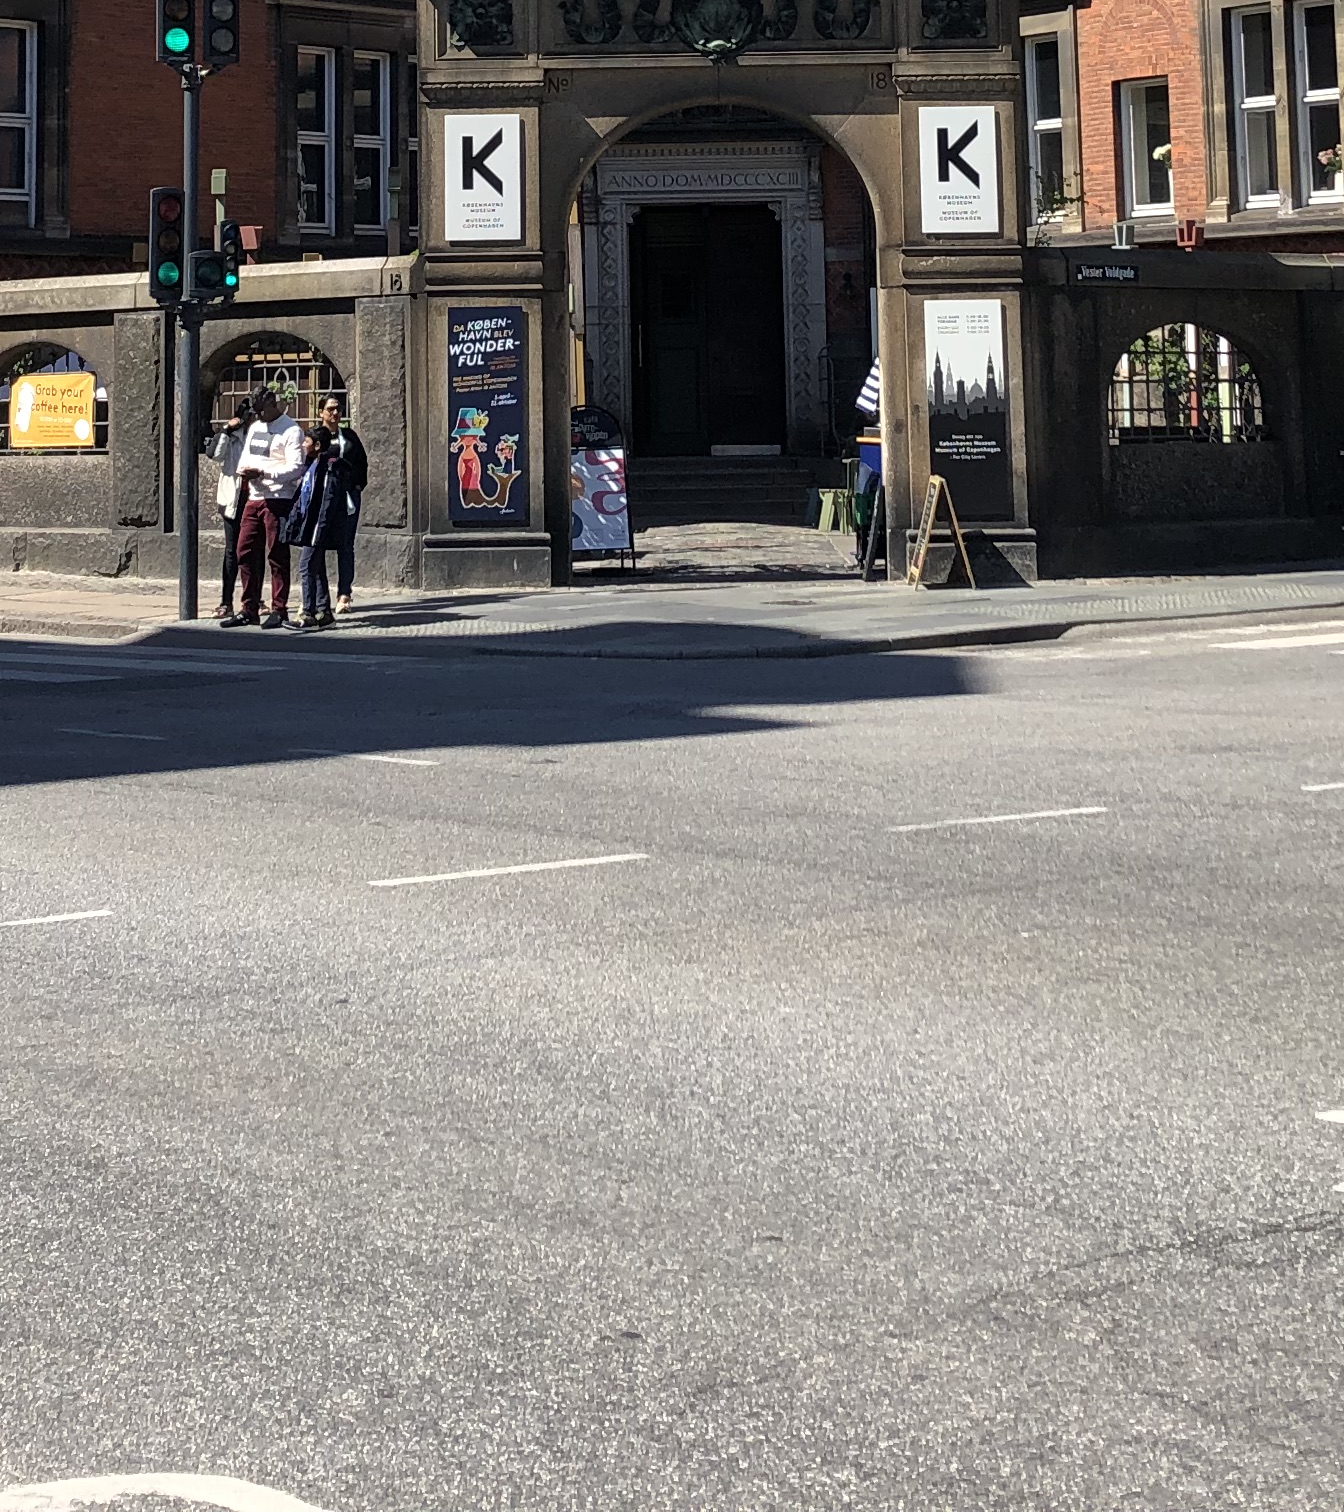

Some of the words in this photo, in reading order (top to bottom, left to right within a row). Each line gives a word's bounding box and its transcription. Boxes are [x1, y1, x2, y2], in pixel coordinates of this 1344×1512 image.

[870, 72, 887, 90] 18
[461, 126, 504, 198] K
[936, 118, 981, 191] K
[608, 173, 658, 189] ANNO
[1080, 265, 1104, 278] Vester
[1104, 265, 1135, 280] Voldgade
[453, 324, 465, 333] DA
[467, 316, 512, 331] KØBEN-
[458, 328, 492, 342] HAVN
[493, 328, 515, 338] BLEV
[449, 338, 521, 356] WONDER-
[457, 353, 485, 368] FUL
[35, 383, 58, 397] Grab
[59, 388, 85, 401] your
[31, 399, 59, 414] coffee
[61, 401, 88, 416] here!
